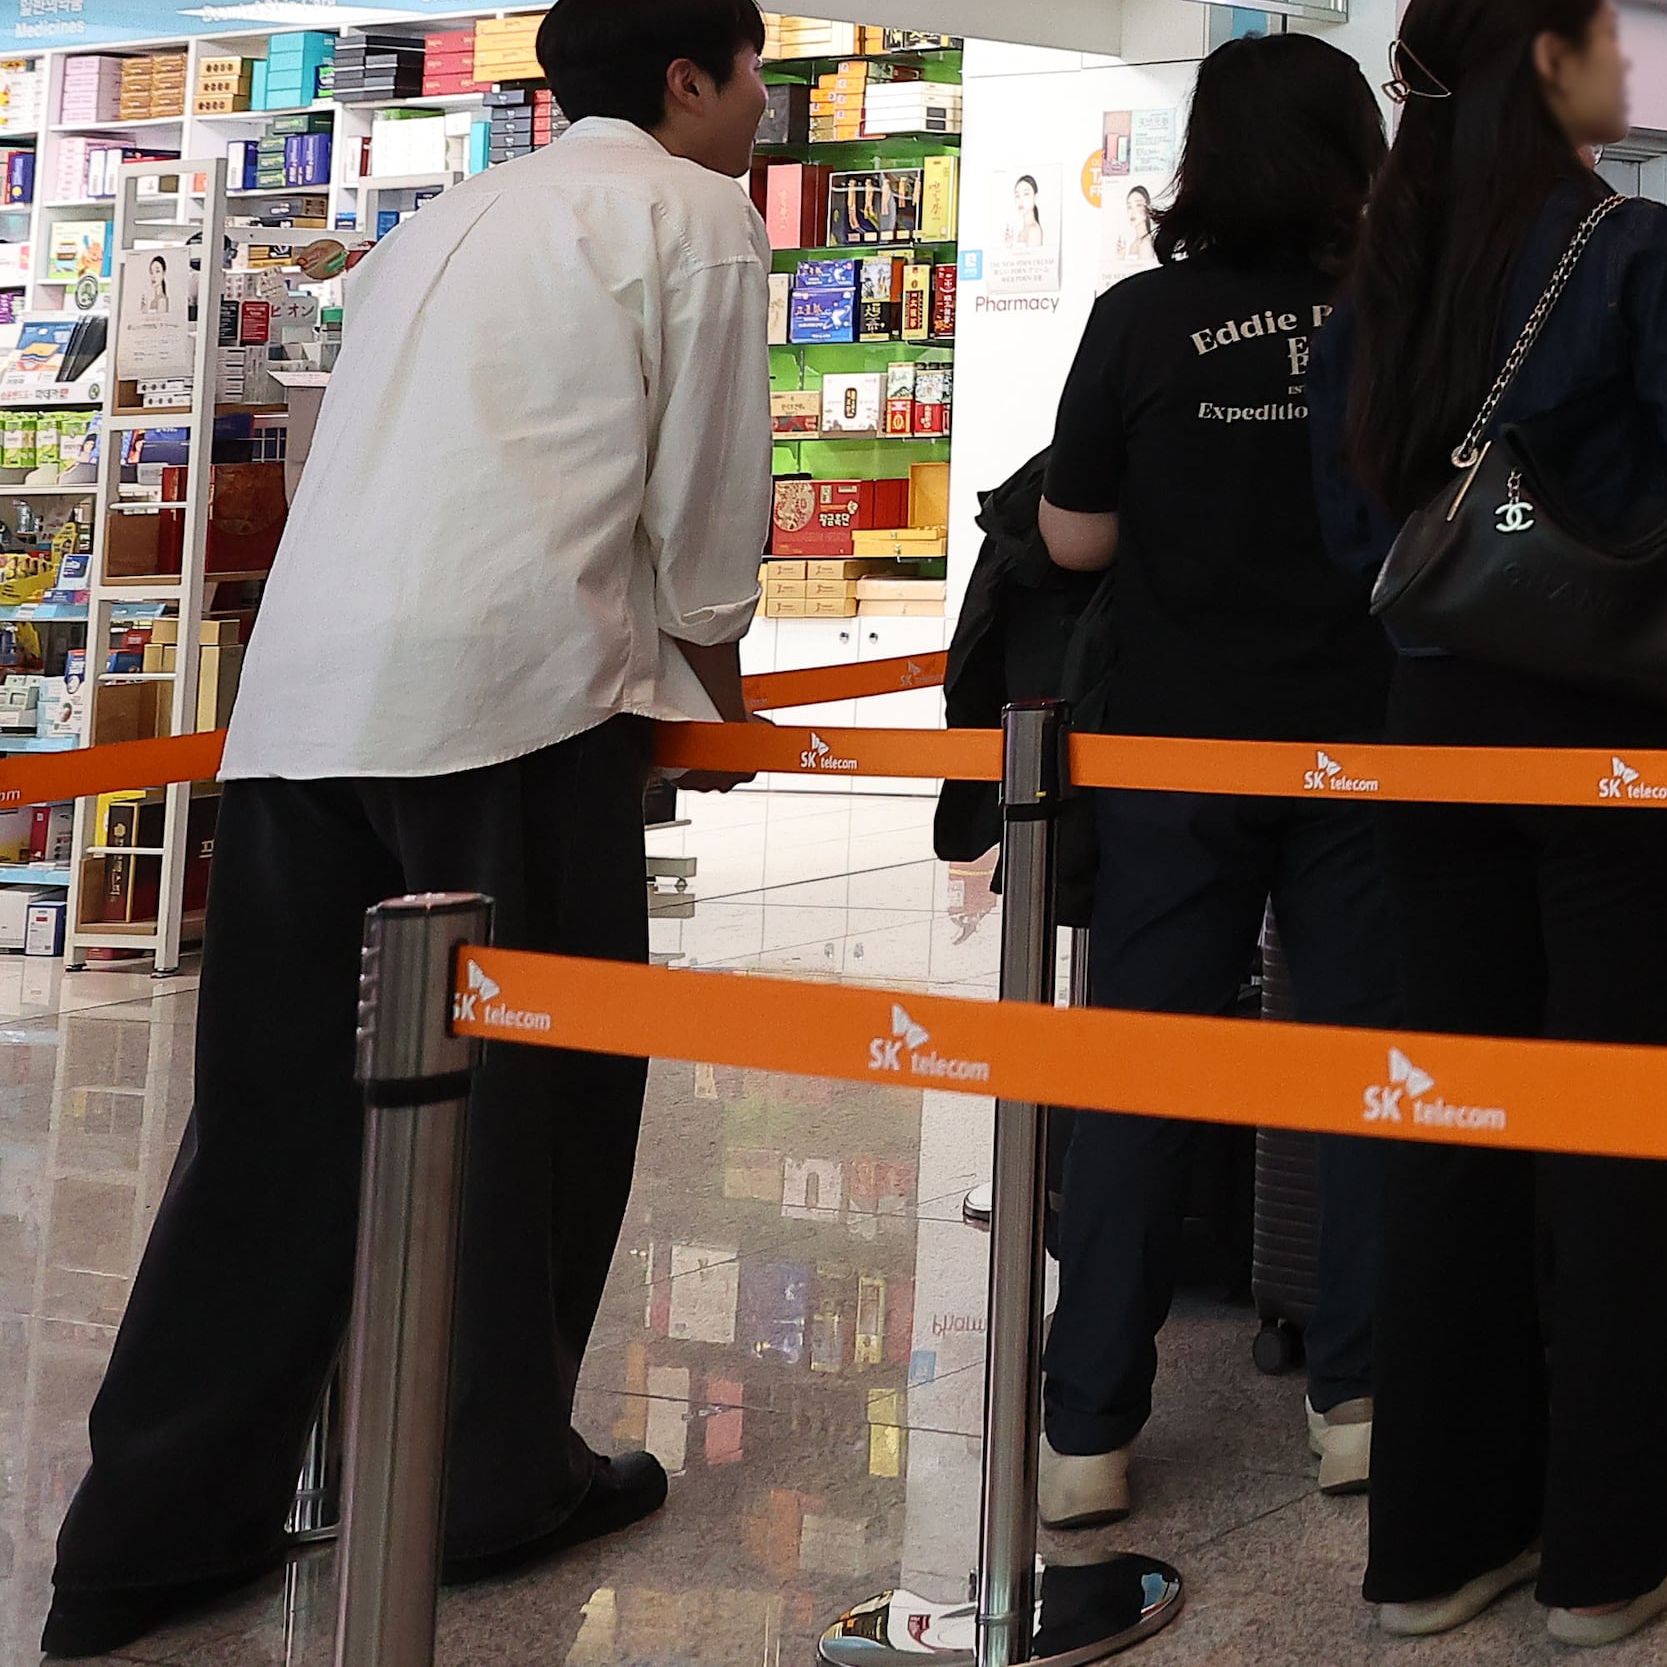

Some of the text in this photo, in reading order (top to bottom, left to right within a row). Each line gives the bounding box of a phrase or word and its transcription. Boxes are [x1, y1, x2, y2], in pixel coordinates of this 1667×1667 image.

[15, 19, 86, 39] Medicines
[975, 295, 1060, 313] Pharmacy
[1189, 310, 1299, 356] Eddie
[1198, 401, 1309, 423] Expeditio
[800, 751, 858, 770] SK telecom
[1303, 771, 1379, 792] SK telecom
[1598, 778, 1621, 798] SK
[484, 1002, 551, 1032] telecom
[868, 1038, 990, 1082] SK telecom
[1363, 1087, 1506, 1131] SK telecom
